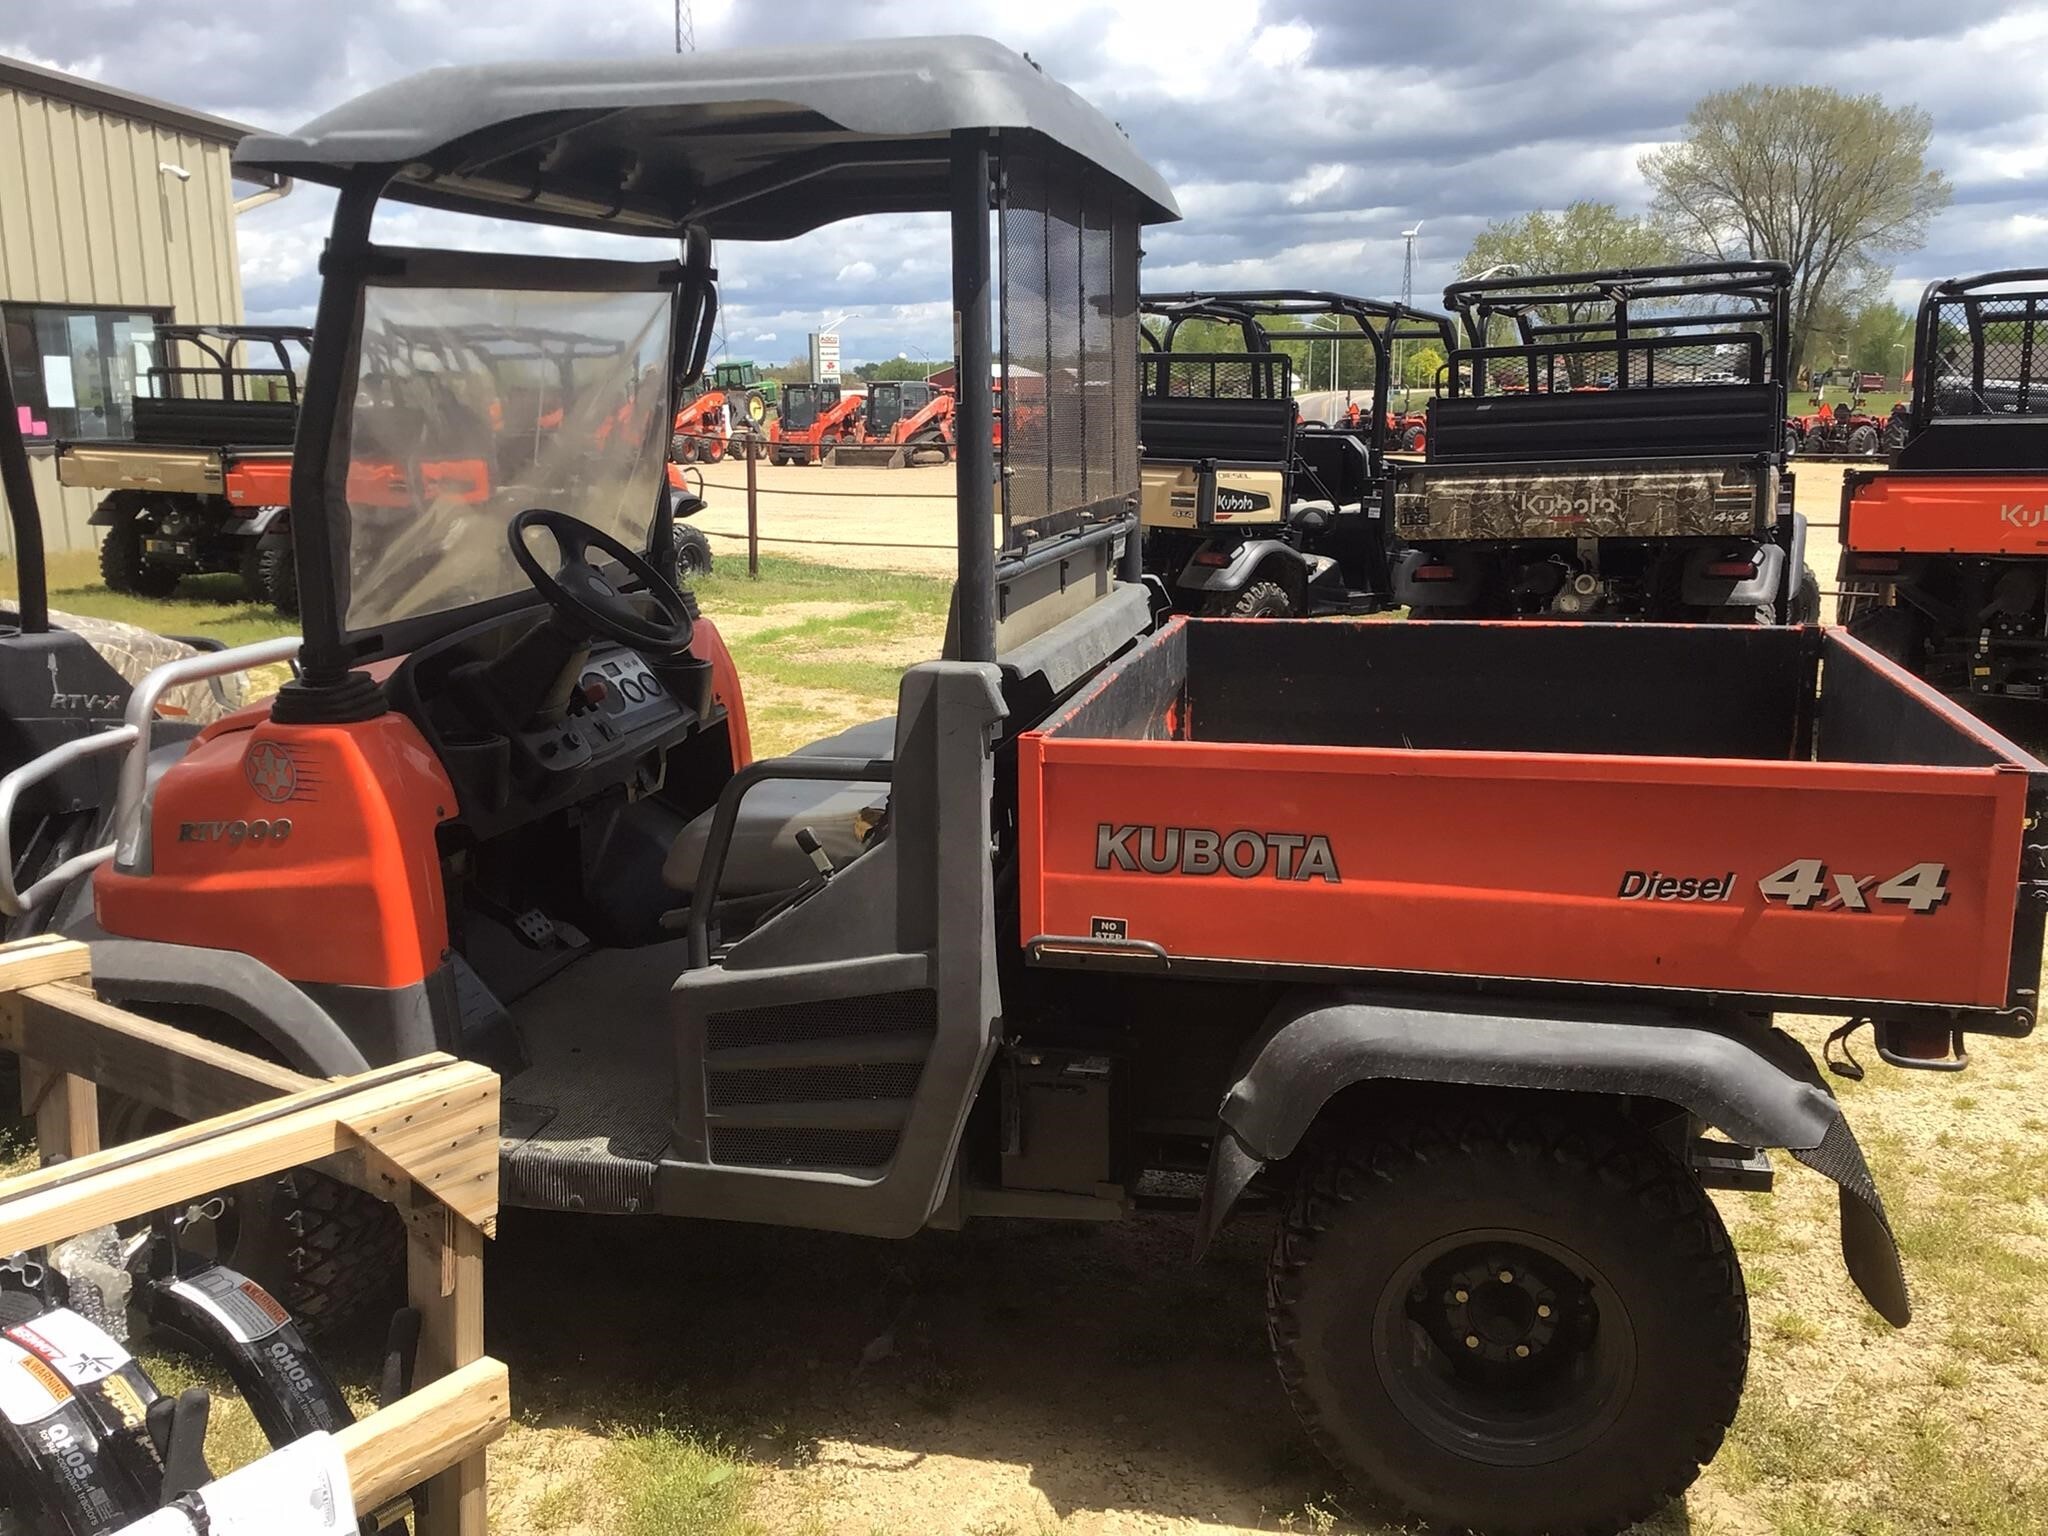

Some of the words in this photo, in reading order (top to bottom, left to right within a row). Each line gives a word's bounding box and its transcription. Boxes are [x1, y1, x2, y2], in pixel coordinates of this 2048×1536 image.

[1217, 494, 1253, 511] Kubota
[1521, 493, 1616, 516] Kubota
[2001, 504, 2048, 527] Ku
[50, 693, 120, 710] RTV-X
[177, 819, 293, 844] RTV900
[1095, 823, 1342, 883] KUBOTA
[1617, 870, 1737, 902] Diesel
[1757, 858, 1951, 915] 4x4
[1101, 921, 1117, 931] NO
[250, 1284, 288, 1323] WARNING
[31, 1361, 69, 1400] WARNING
[271, 1342, 314, 1392] QH05
[47, 1423, 94, 1480] QH05
[78, 1492, 99, 1526] tractors
